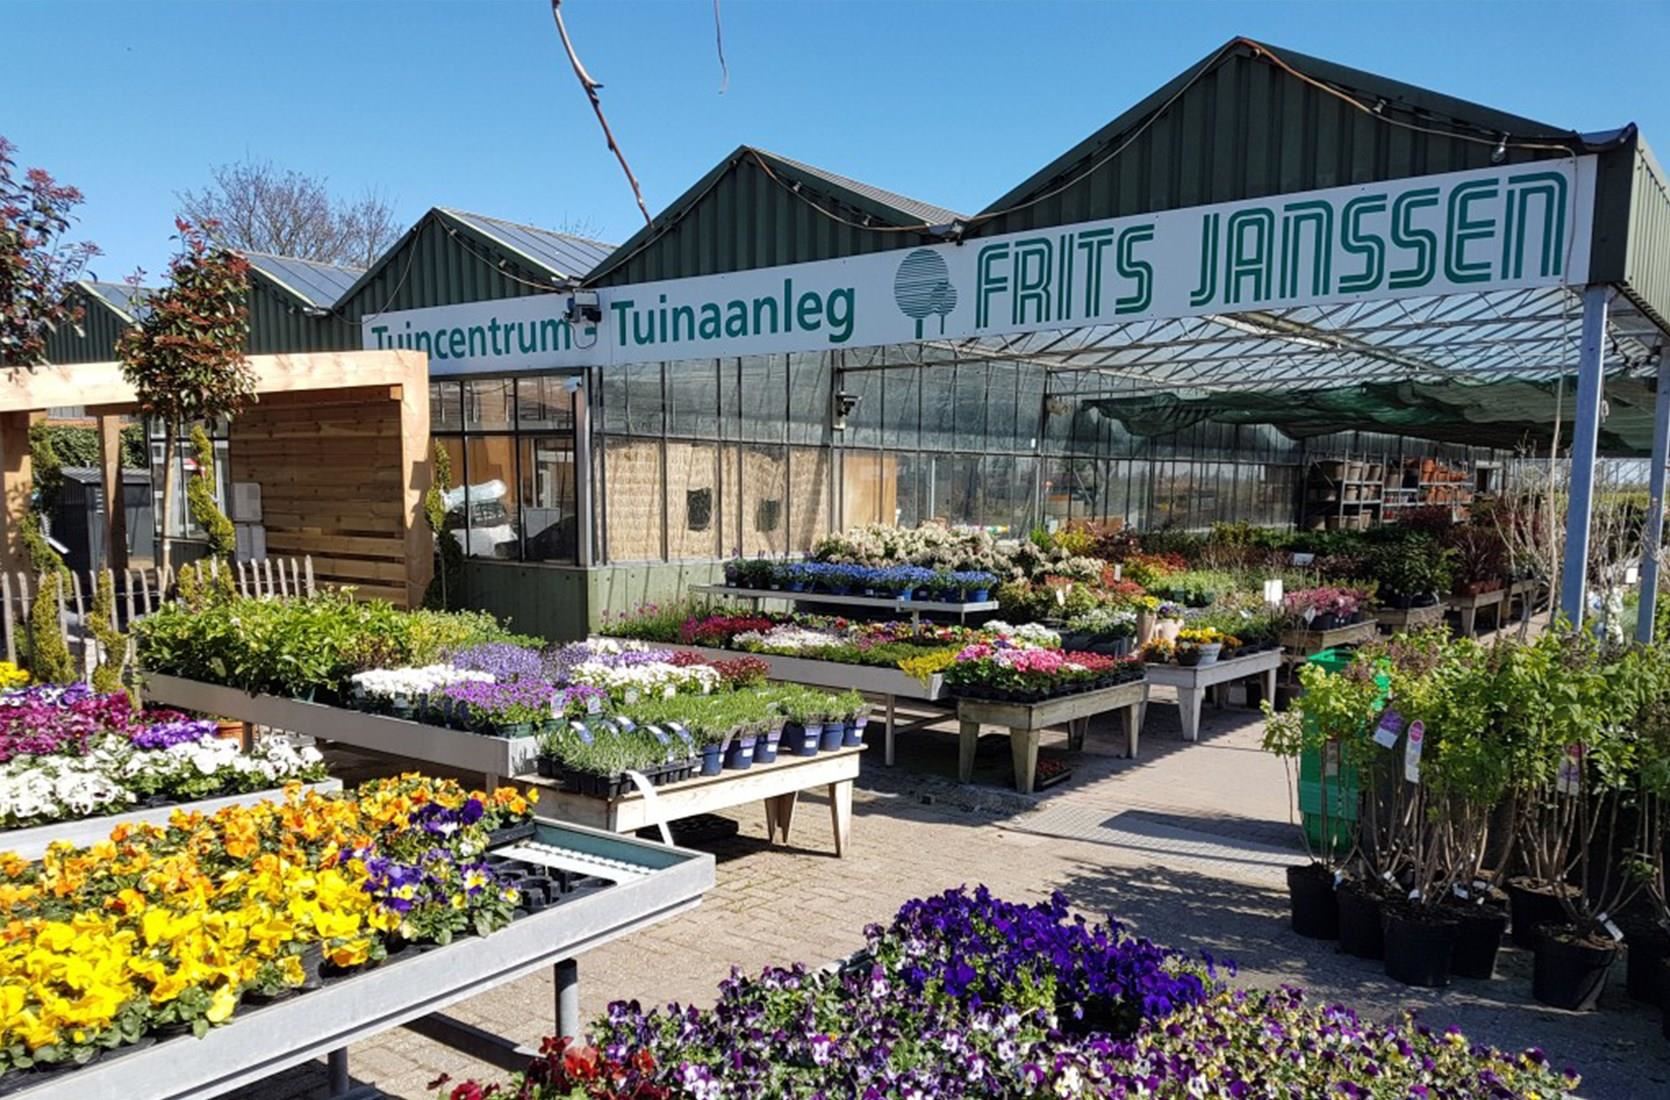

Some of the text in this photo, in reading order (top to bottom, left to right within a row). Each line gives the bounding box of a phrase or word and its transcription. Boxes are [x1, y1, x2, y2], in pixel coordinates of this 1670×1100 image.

[611, 278, 856, 346] Tuinaanleg
[975, 224, 1156, 330] FRITS
[1189, 171, 1569, 307] JANSSEN
